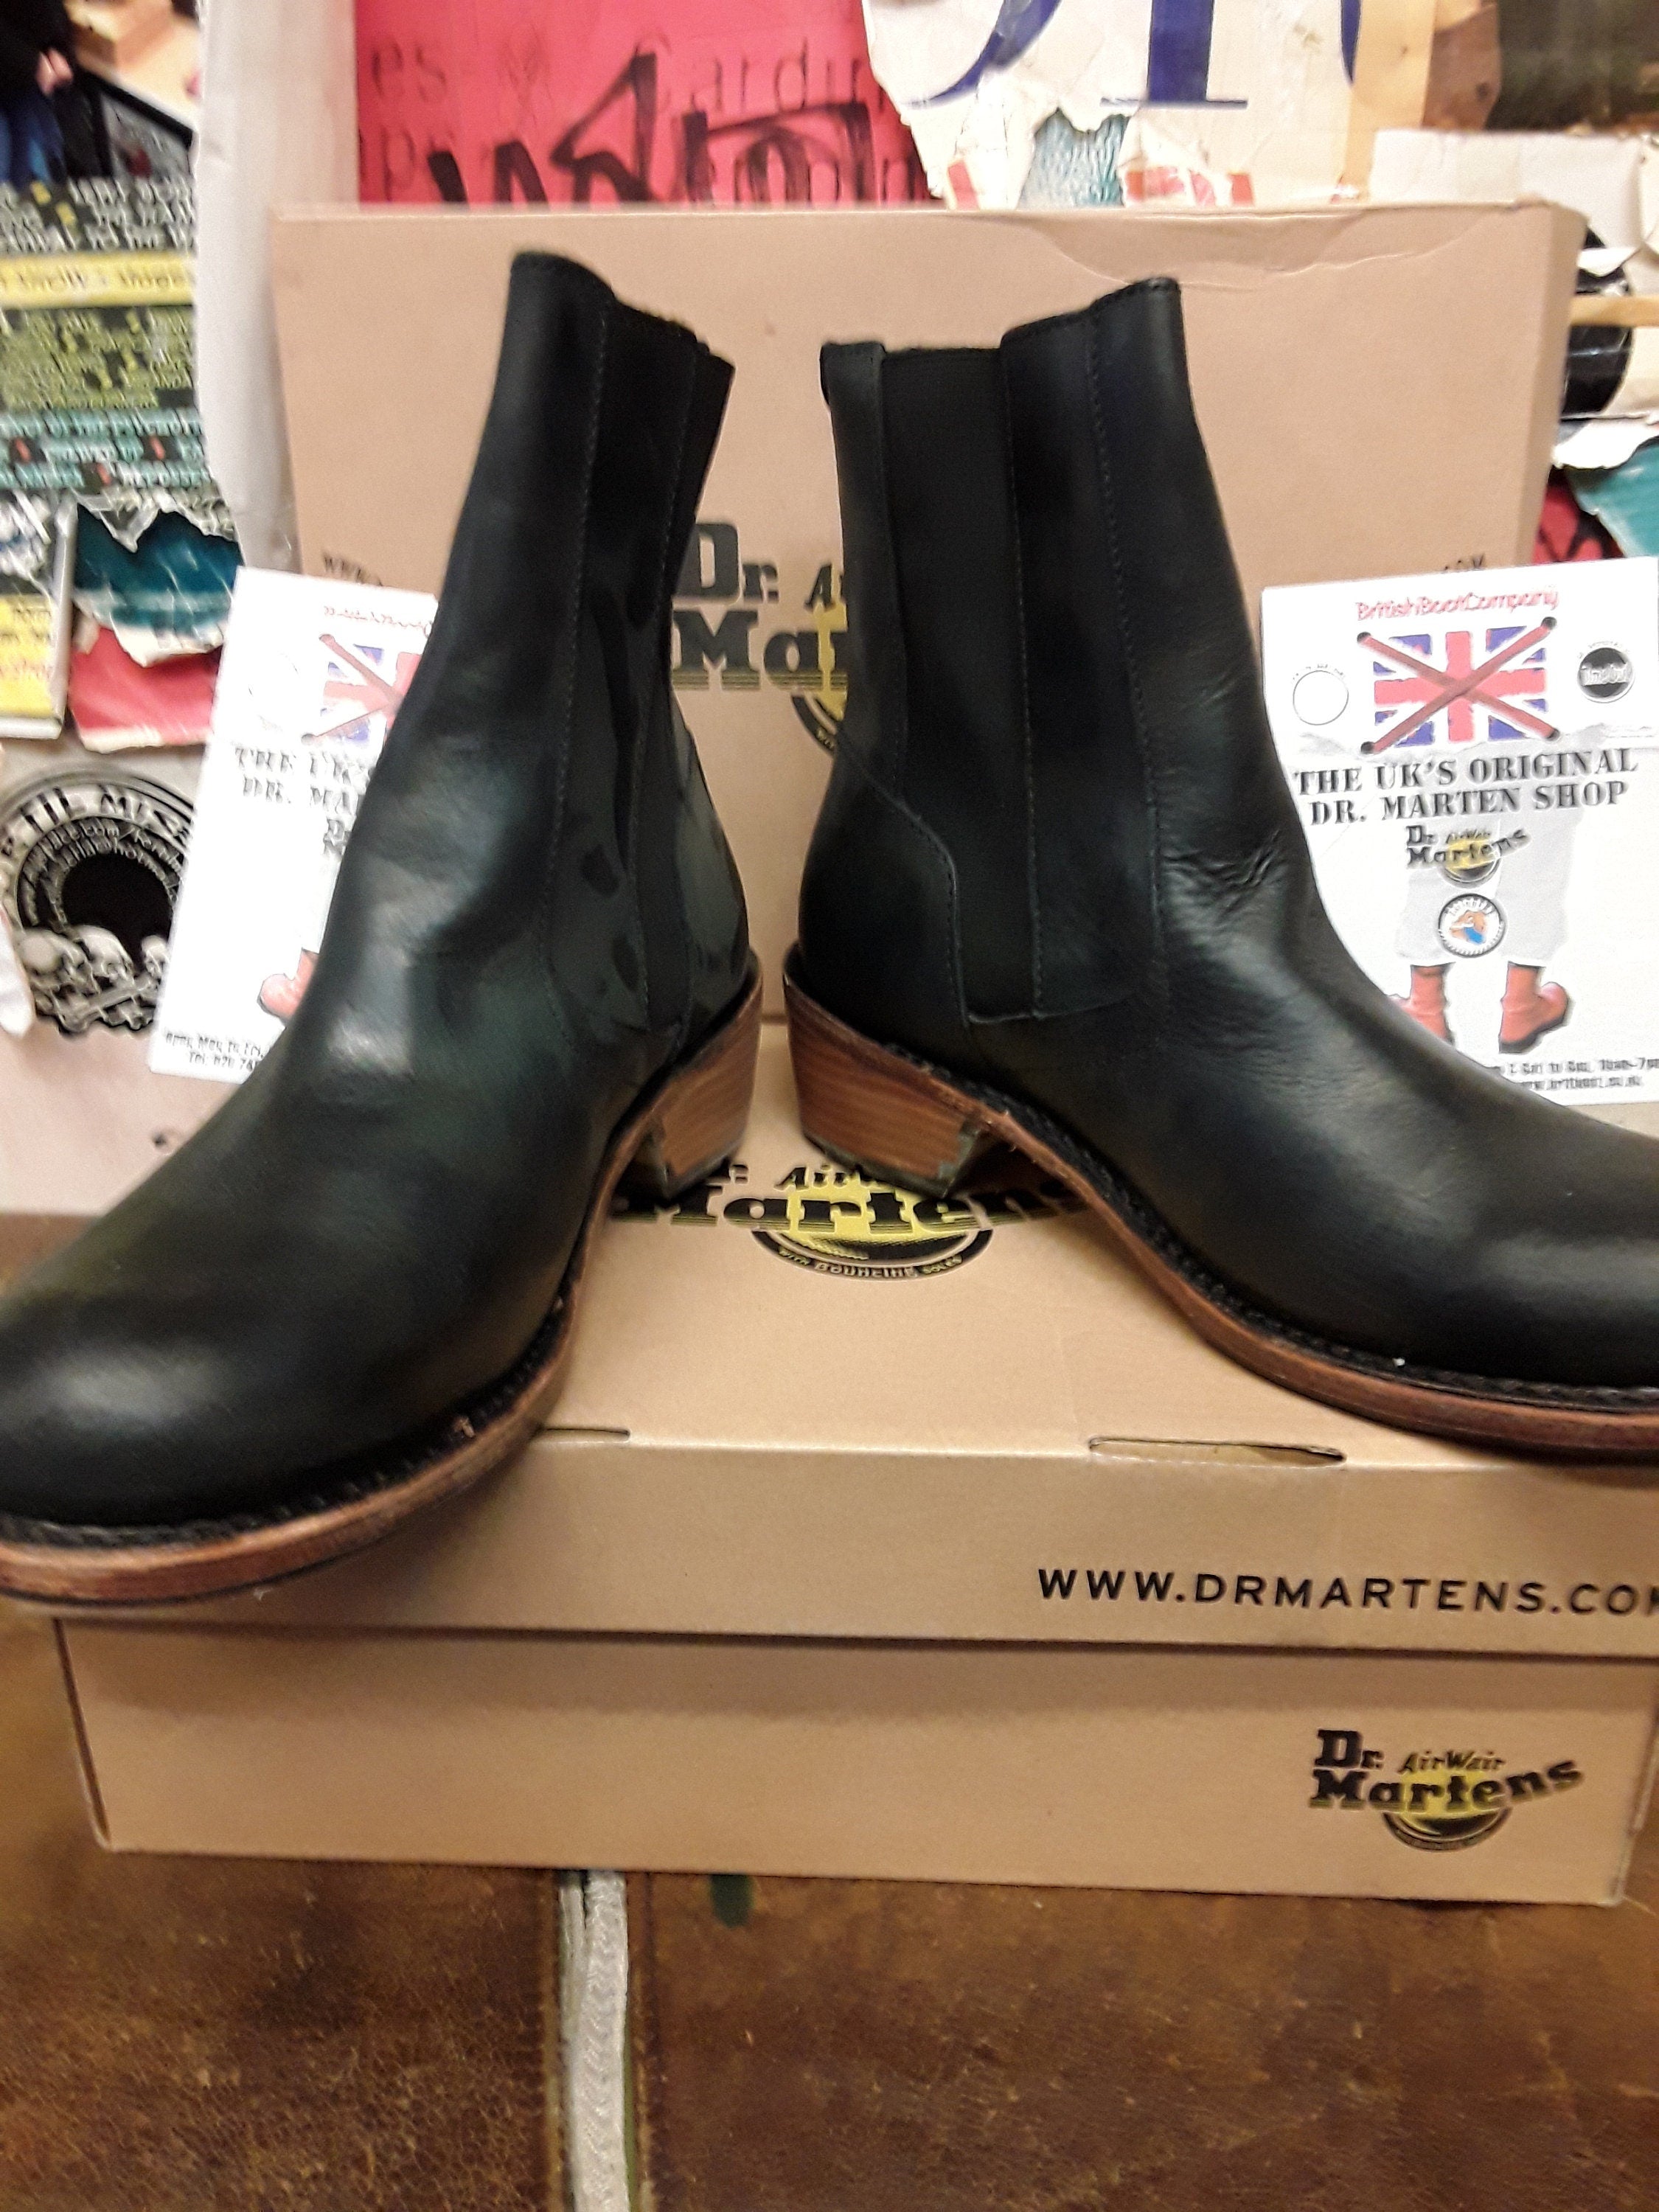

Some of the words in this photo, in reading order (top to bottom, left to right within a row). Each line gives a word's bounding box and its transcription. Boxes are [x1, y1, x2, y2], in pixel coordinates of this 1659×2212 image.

[1293, 767, 1363, 796] THE
[1374, 759, 1457, 789] UK'S
[1469, 748, 1639, 784] ORIGINAL
[1309, 799, 1367, 826] DR.
[1381, 787, 1520, 821] MARTEN
[1534, 780, 1629, 810] SHOP
[1314, 1728, 1385, 1769] Dr.
[1309, 1759, 1585, 1812] Martens
